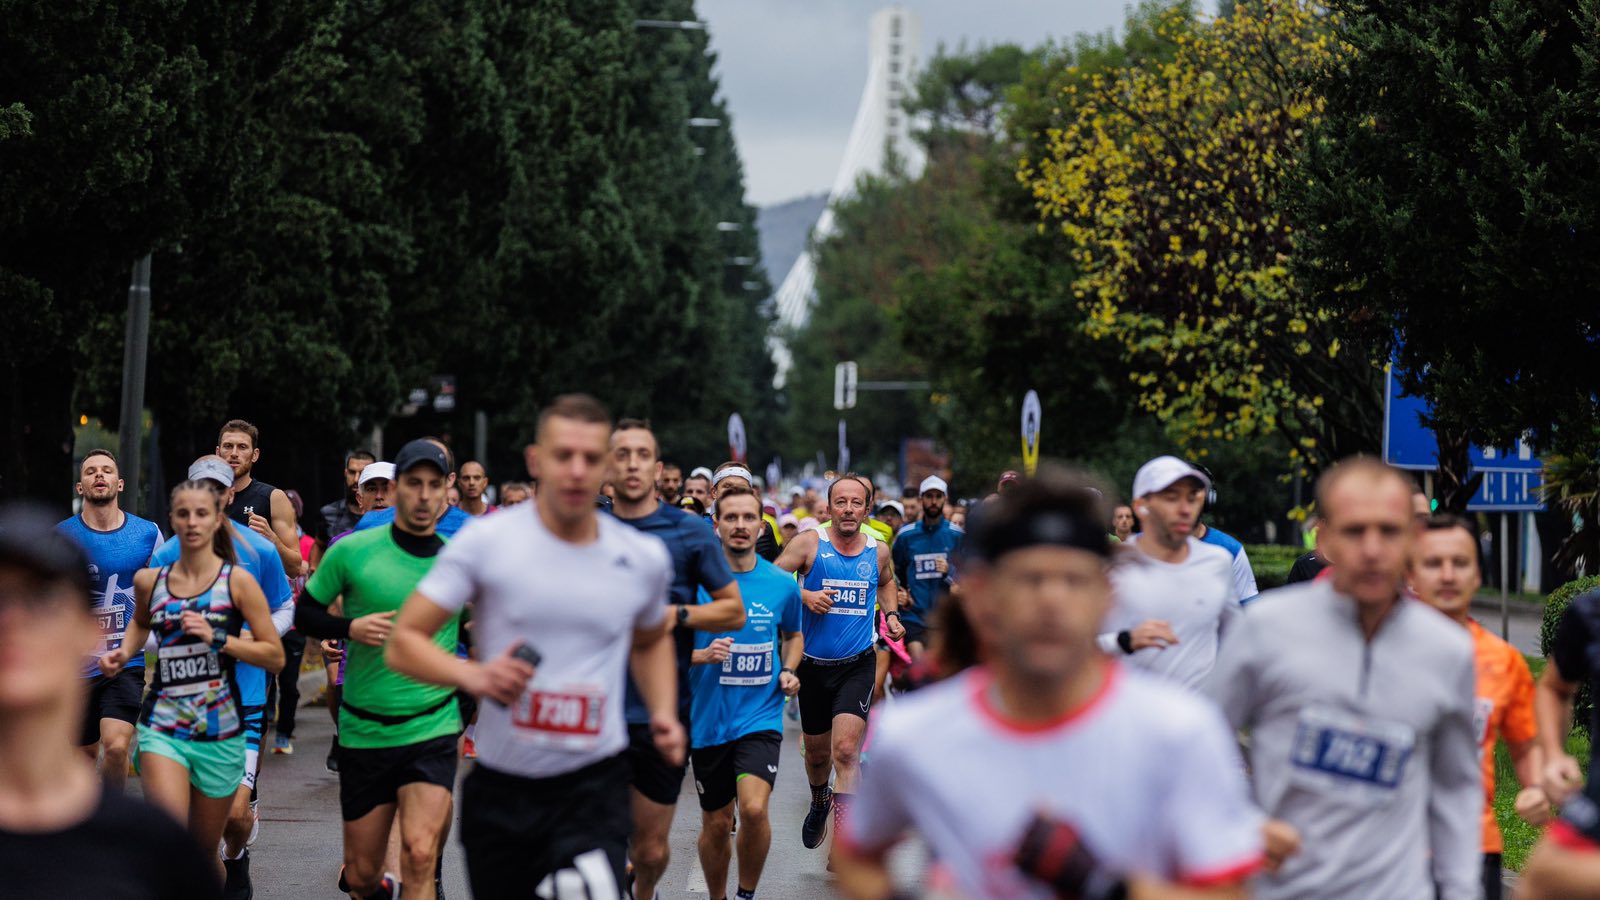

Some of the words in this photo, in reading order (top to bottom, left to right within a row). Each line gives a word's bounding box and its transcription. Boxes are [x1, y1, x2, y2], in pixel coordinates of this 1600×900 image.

[833, 589, 856, 603] 946
[168, 656, 208, 680] 1302
[736, 655, 763, 671] 887
